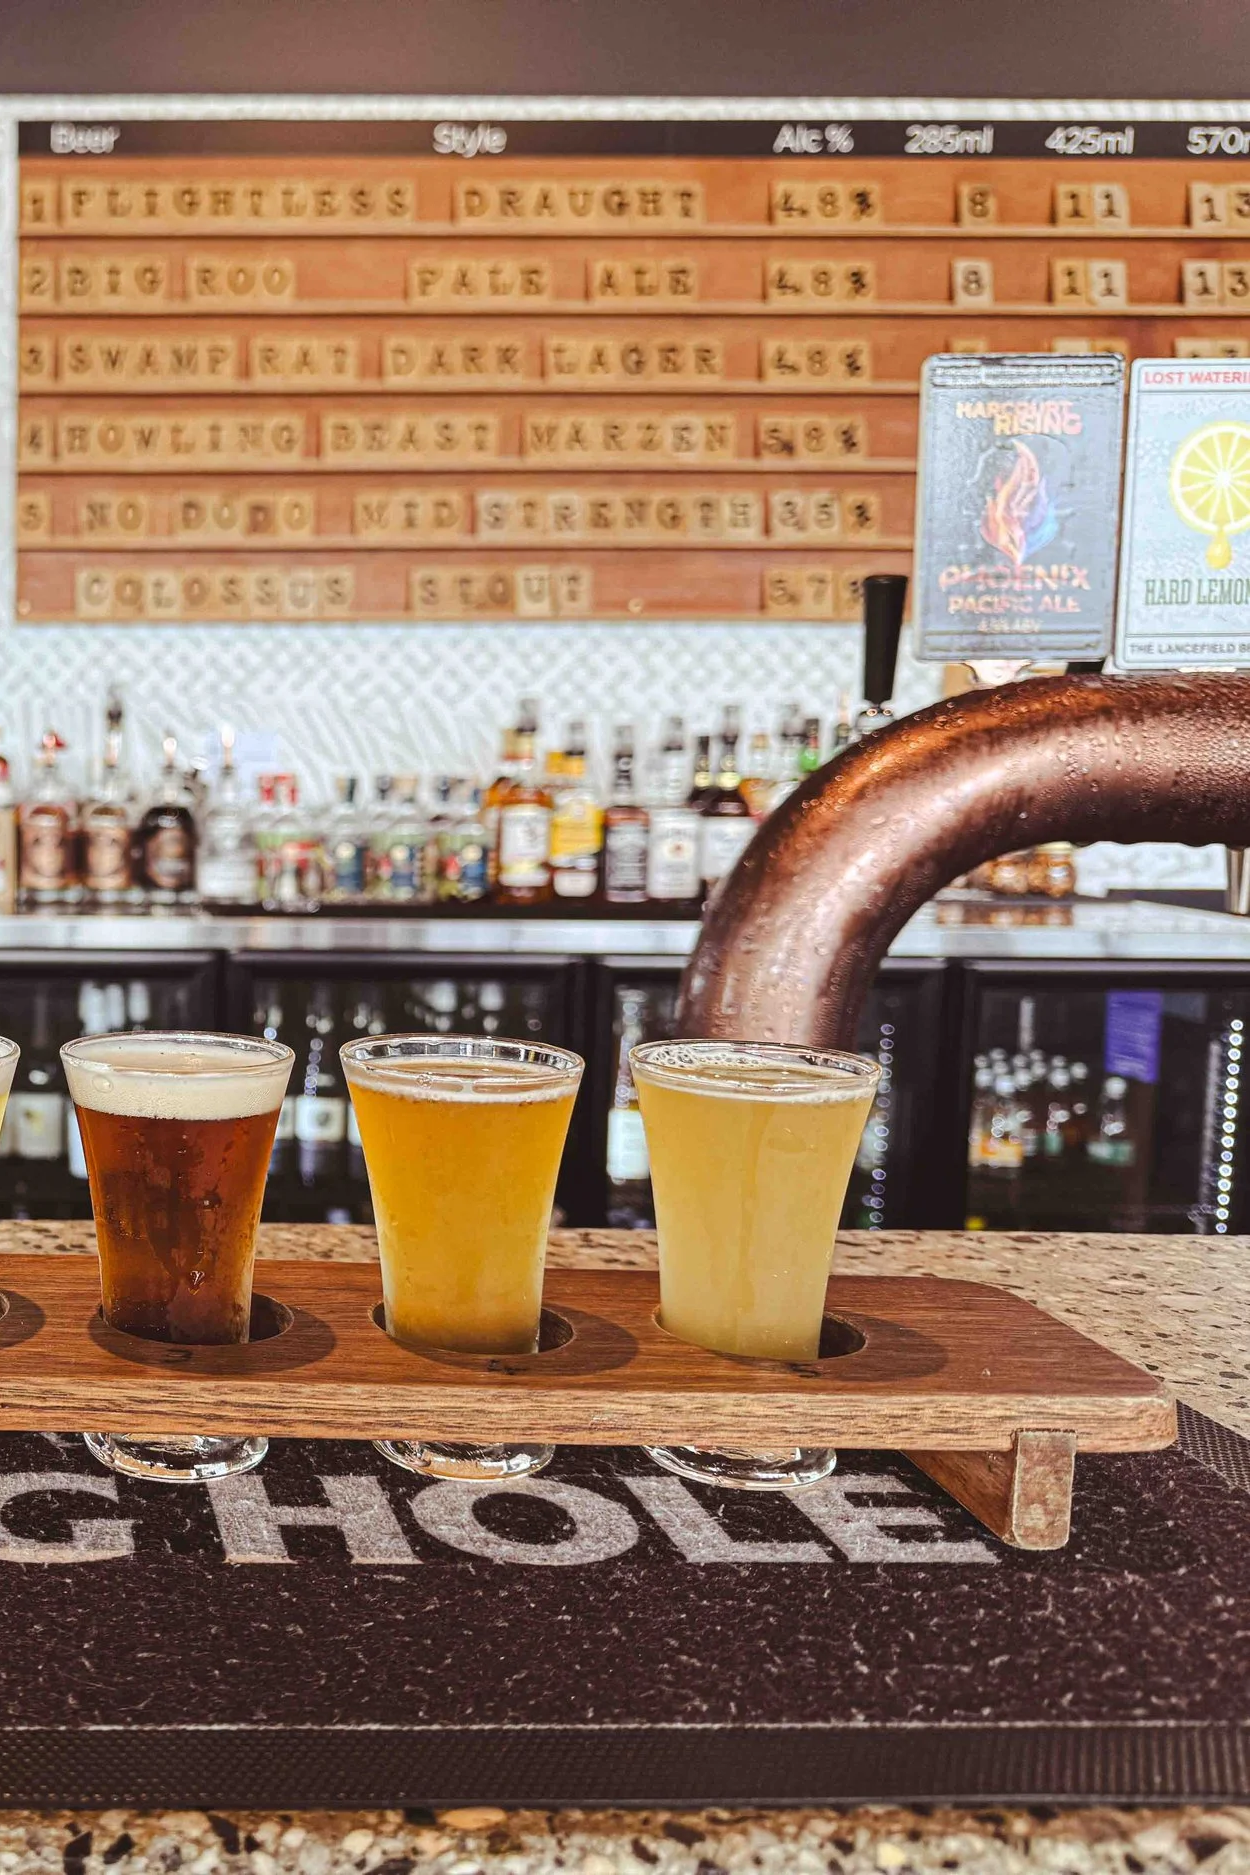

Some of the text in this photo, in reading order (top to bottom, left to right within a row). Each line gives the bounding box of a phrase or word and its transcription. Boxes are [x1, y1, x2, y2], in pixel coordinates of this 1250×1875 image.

[50, 121, 120, 154] Beer
[433, 121, 507, 158] Style
[772, 123, 824, 154] Alc
[825, 123, 855, 154] %
[904, 124, 994, 154] 285ml
[1045, 125, 1135, 155] 425ml
[29, 189, 47, 221] 1
[70, 187, 411, 219] FLIGHTLESS
[462, 187, 697, 219] DRAUGHT
[967, 183, 990, 219] 8
[1066, 190, 1120, 219] 11
[1200, 191, 1250, 222] 13
[27, 265, 49, 297] 2
[66, 265, 164, 297] BIG
[194, 265, 291, 297] ROO
[415, 266, 547, 298] PALE
[597, 266, 694, 298] ALE
[960, 264, 984, 298] 8
[1061, 266, 1120, 297] 11
[1196, 269, 1250, 298] 13
[23, 344, 46, 376] 3
[67, 344, 228, 376] SWAMP
[258, 344, 350, 376] RAT
[390, 345, 520, 377] DARK
[553, 345, 721, 377] LAGER
[1144, 370, 1250, 385] LOST WATERI
[26, 423, 44, 453] 4
[66, 423, 299, 453] HOWLING
[330, 423, 490, 453] BEAST
[529, 423, 729, 454] MARZEN
[993, 413, 1083, 436] RISING
[20, 503, 44, 531] 5
[85, 502, 144, 532] NO
[180, 502, 312, 532] DODO
[360, 502, 461, 532] MID
[481, 500, 755, 533] STRENGTH
[84, 576, 348, 607] COLOSSUS
[418, 575, 583, 607] STOUT
[938, 564, 1092, 592] PHOENIX
[1144, 578, 1191, 606] HARD
[948, 595, 1082, 615] PACIFIC ALE
[1129, 643, 1154, 655] THE
[1157, 642, 1236, 655] LANCEFIELD
[206, 1472, 1002, 1567] HOLE
